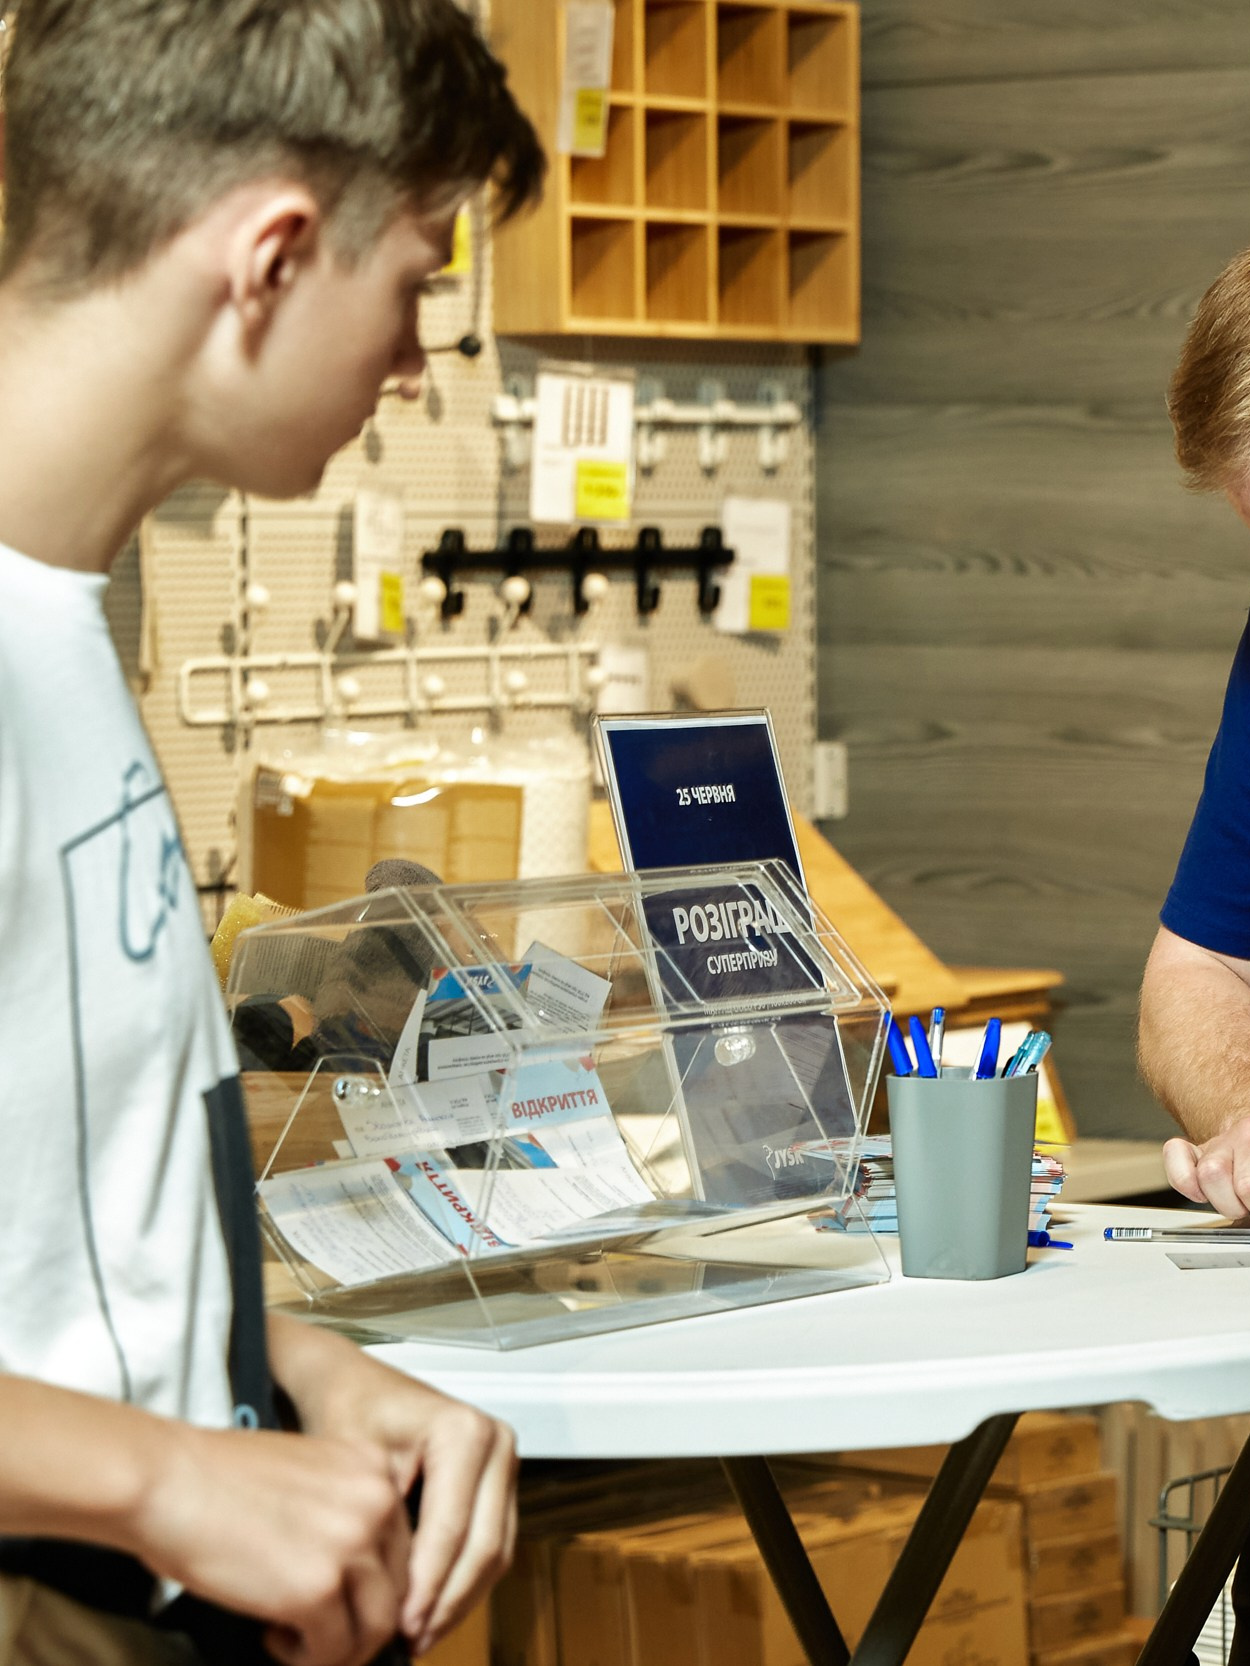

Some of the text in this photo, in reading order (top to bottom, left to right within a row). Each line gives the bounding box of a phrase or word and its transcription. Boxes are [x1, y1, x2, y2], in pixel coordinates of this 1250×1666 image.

[676, 784, 736, 806] 25 ЧЕРВНЯ
[707, 949, 778, 975] СУПЕРПРИЗУ
[511, 1089, 598, 1120] ВІДКРИТТЯ
